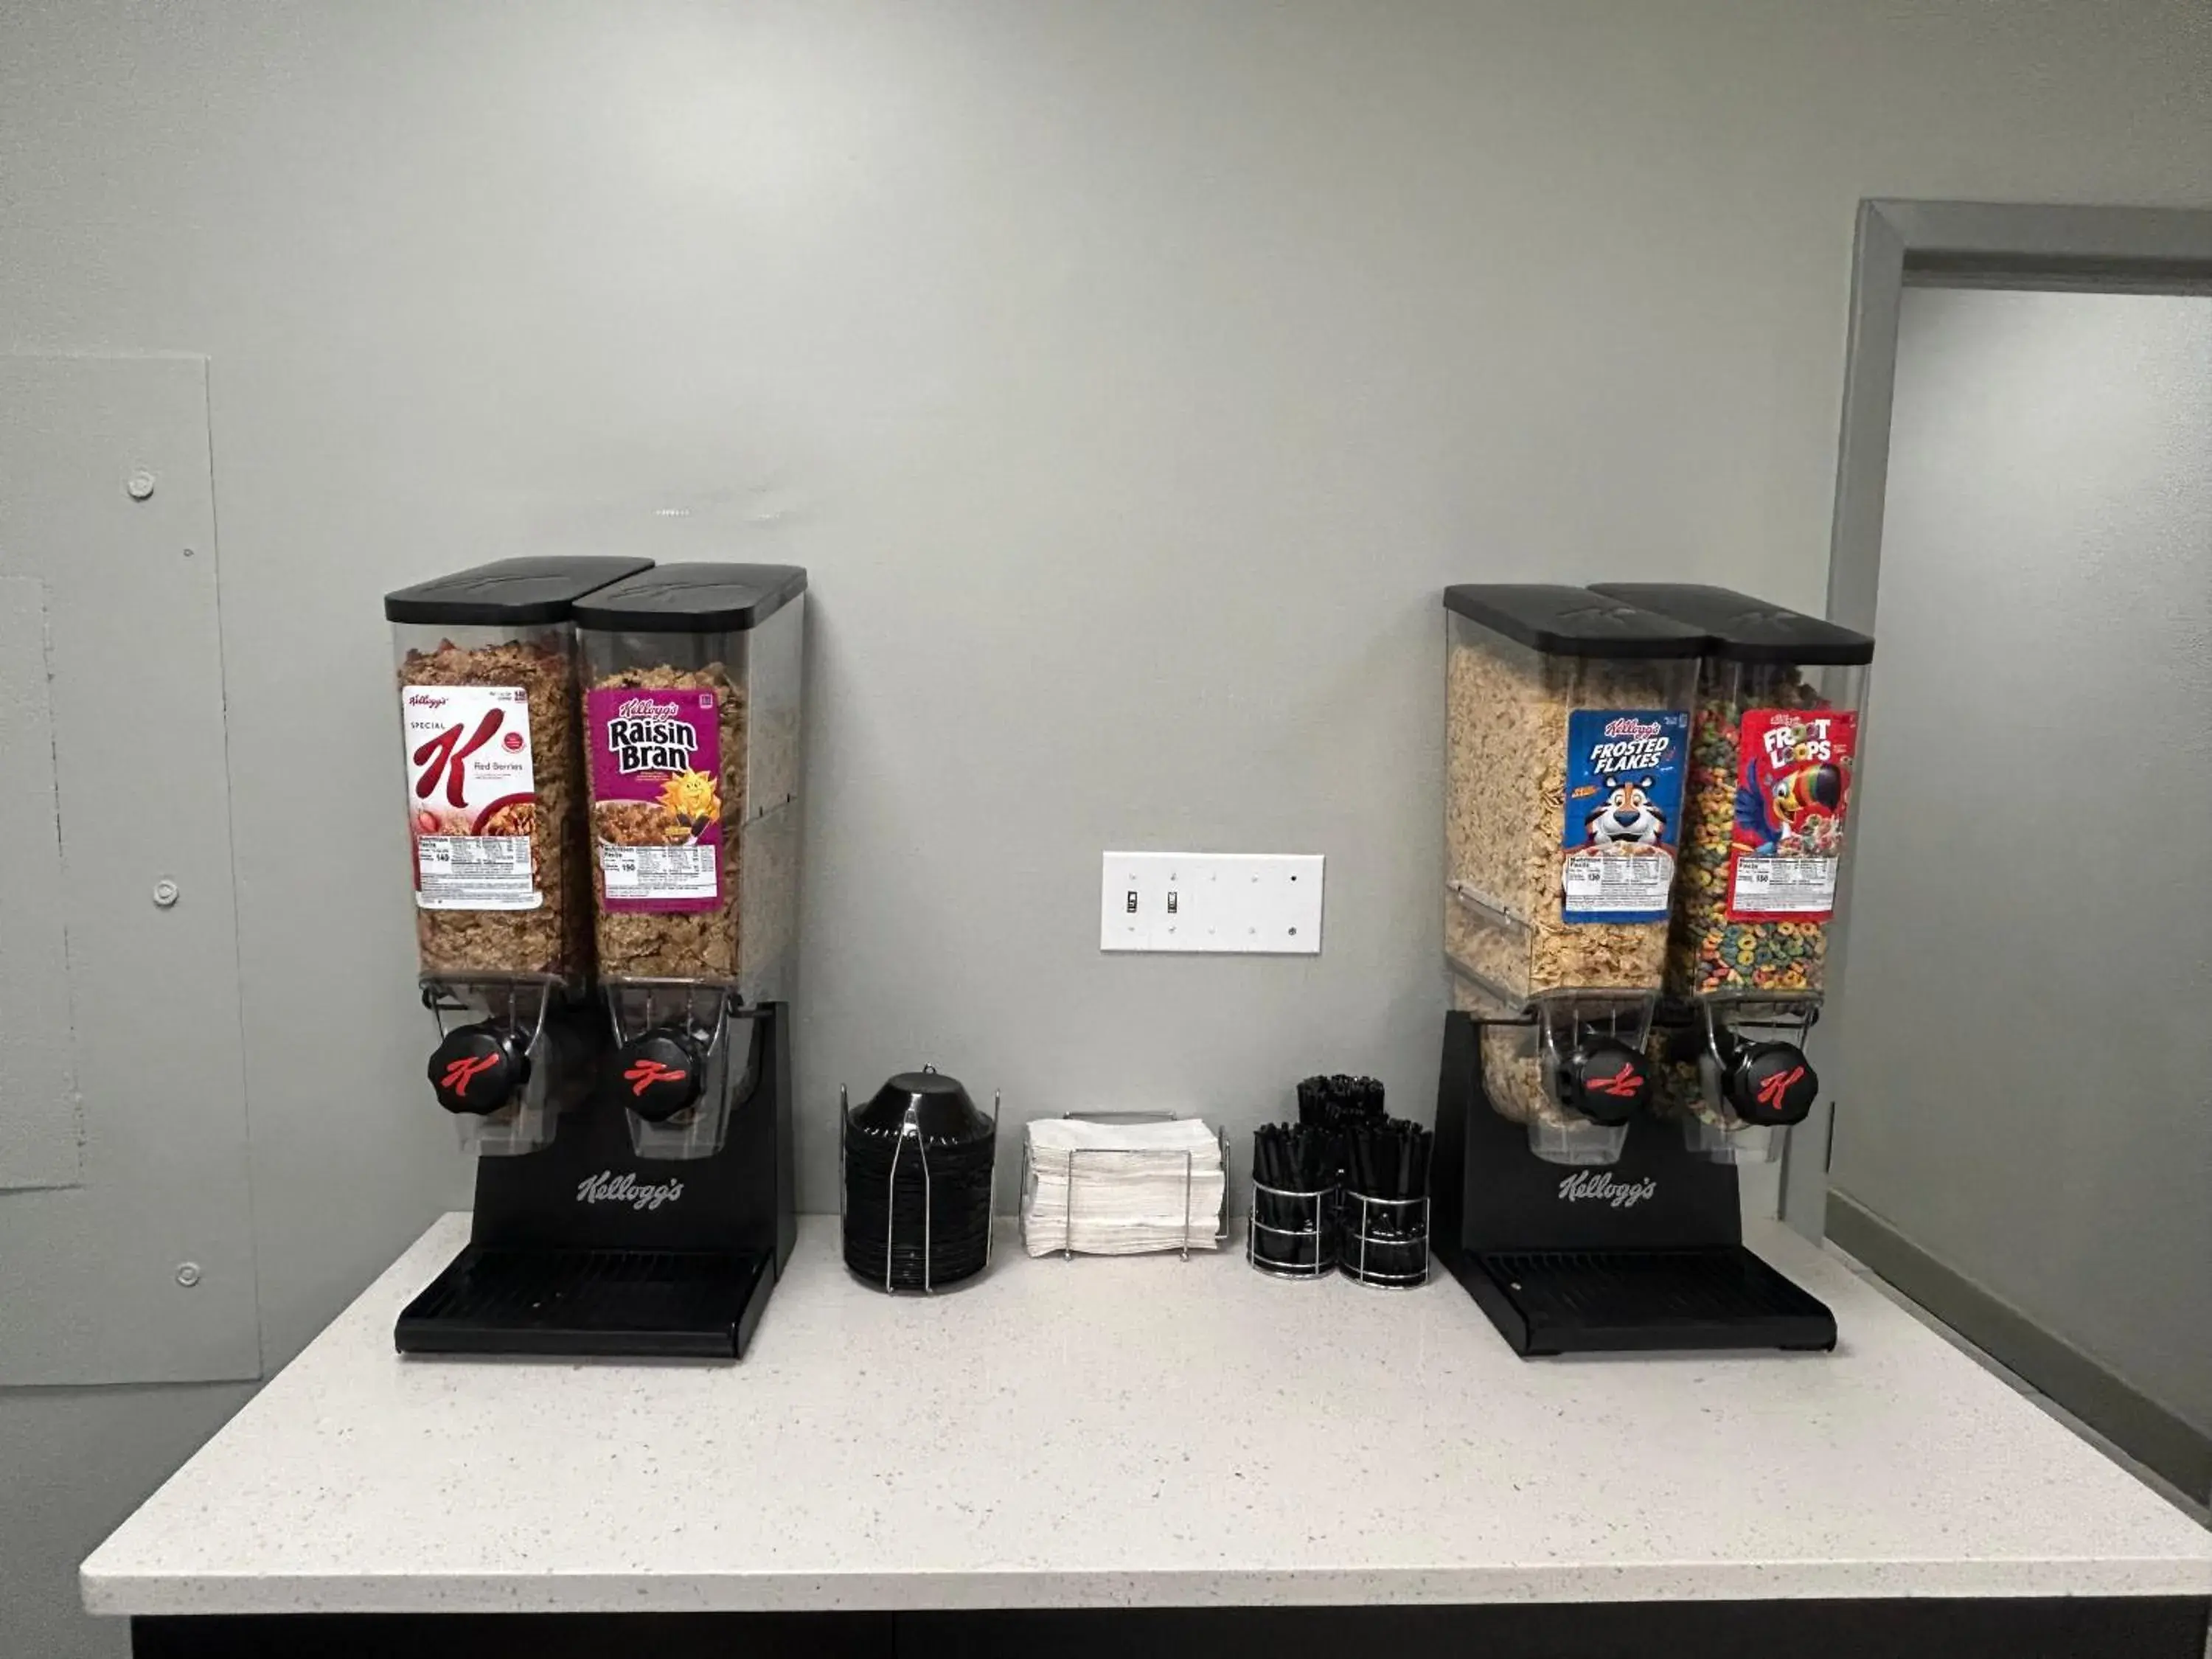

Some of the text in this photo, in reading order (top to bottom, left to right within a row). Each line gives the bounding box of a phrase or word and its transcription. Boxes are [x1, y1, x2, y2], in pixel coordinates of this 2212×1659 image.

[619, 698, 679, 723] Kellogg's
[608, 719, 697, 751] Raisin
[1604, 717, 1661, 742] Kellogg's
[1763, 719, 1831, 753] FROOT
[414, 708, 506, 808] K
[620, 745, 689, 773] Bran
[1590, 737, 1670, 760] FROSTED
[1594, 752, 1661, 773] FLAKES
[1770, 740, 1831, 769] LOOPS
[576, 1169, 684, 1210] Kellogg's
[1559, 1169, 1657, 1208] Kellogg's
